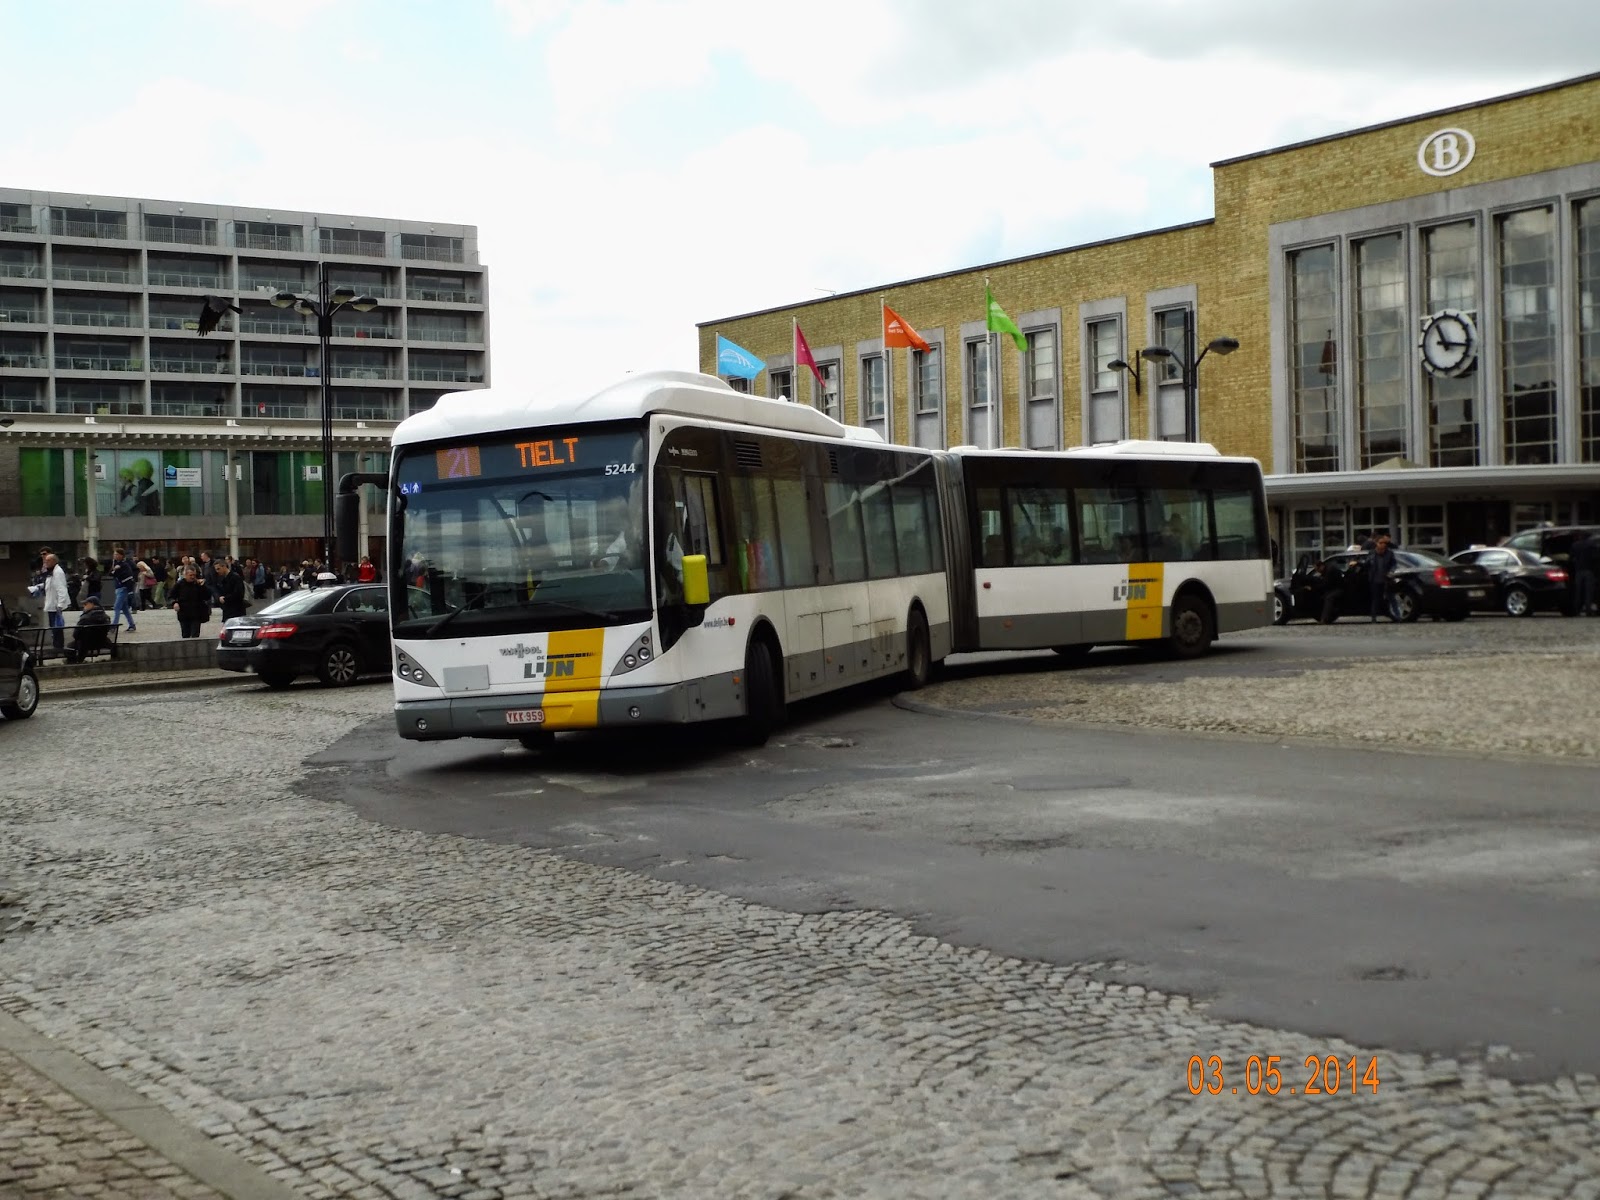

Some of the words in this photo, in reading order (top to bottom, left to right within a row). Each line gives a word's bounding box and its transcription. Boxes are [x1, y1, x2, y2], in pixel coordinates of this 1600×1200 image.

[1433, 134, 1460, 169] B
[448, 448, 471, 478] 21
[515, 437, 579, 468] TIELT
[604, 462, 636, 476] 5244
